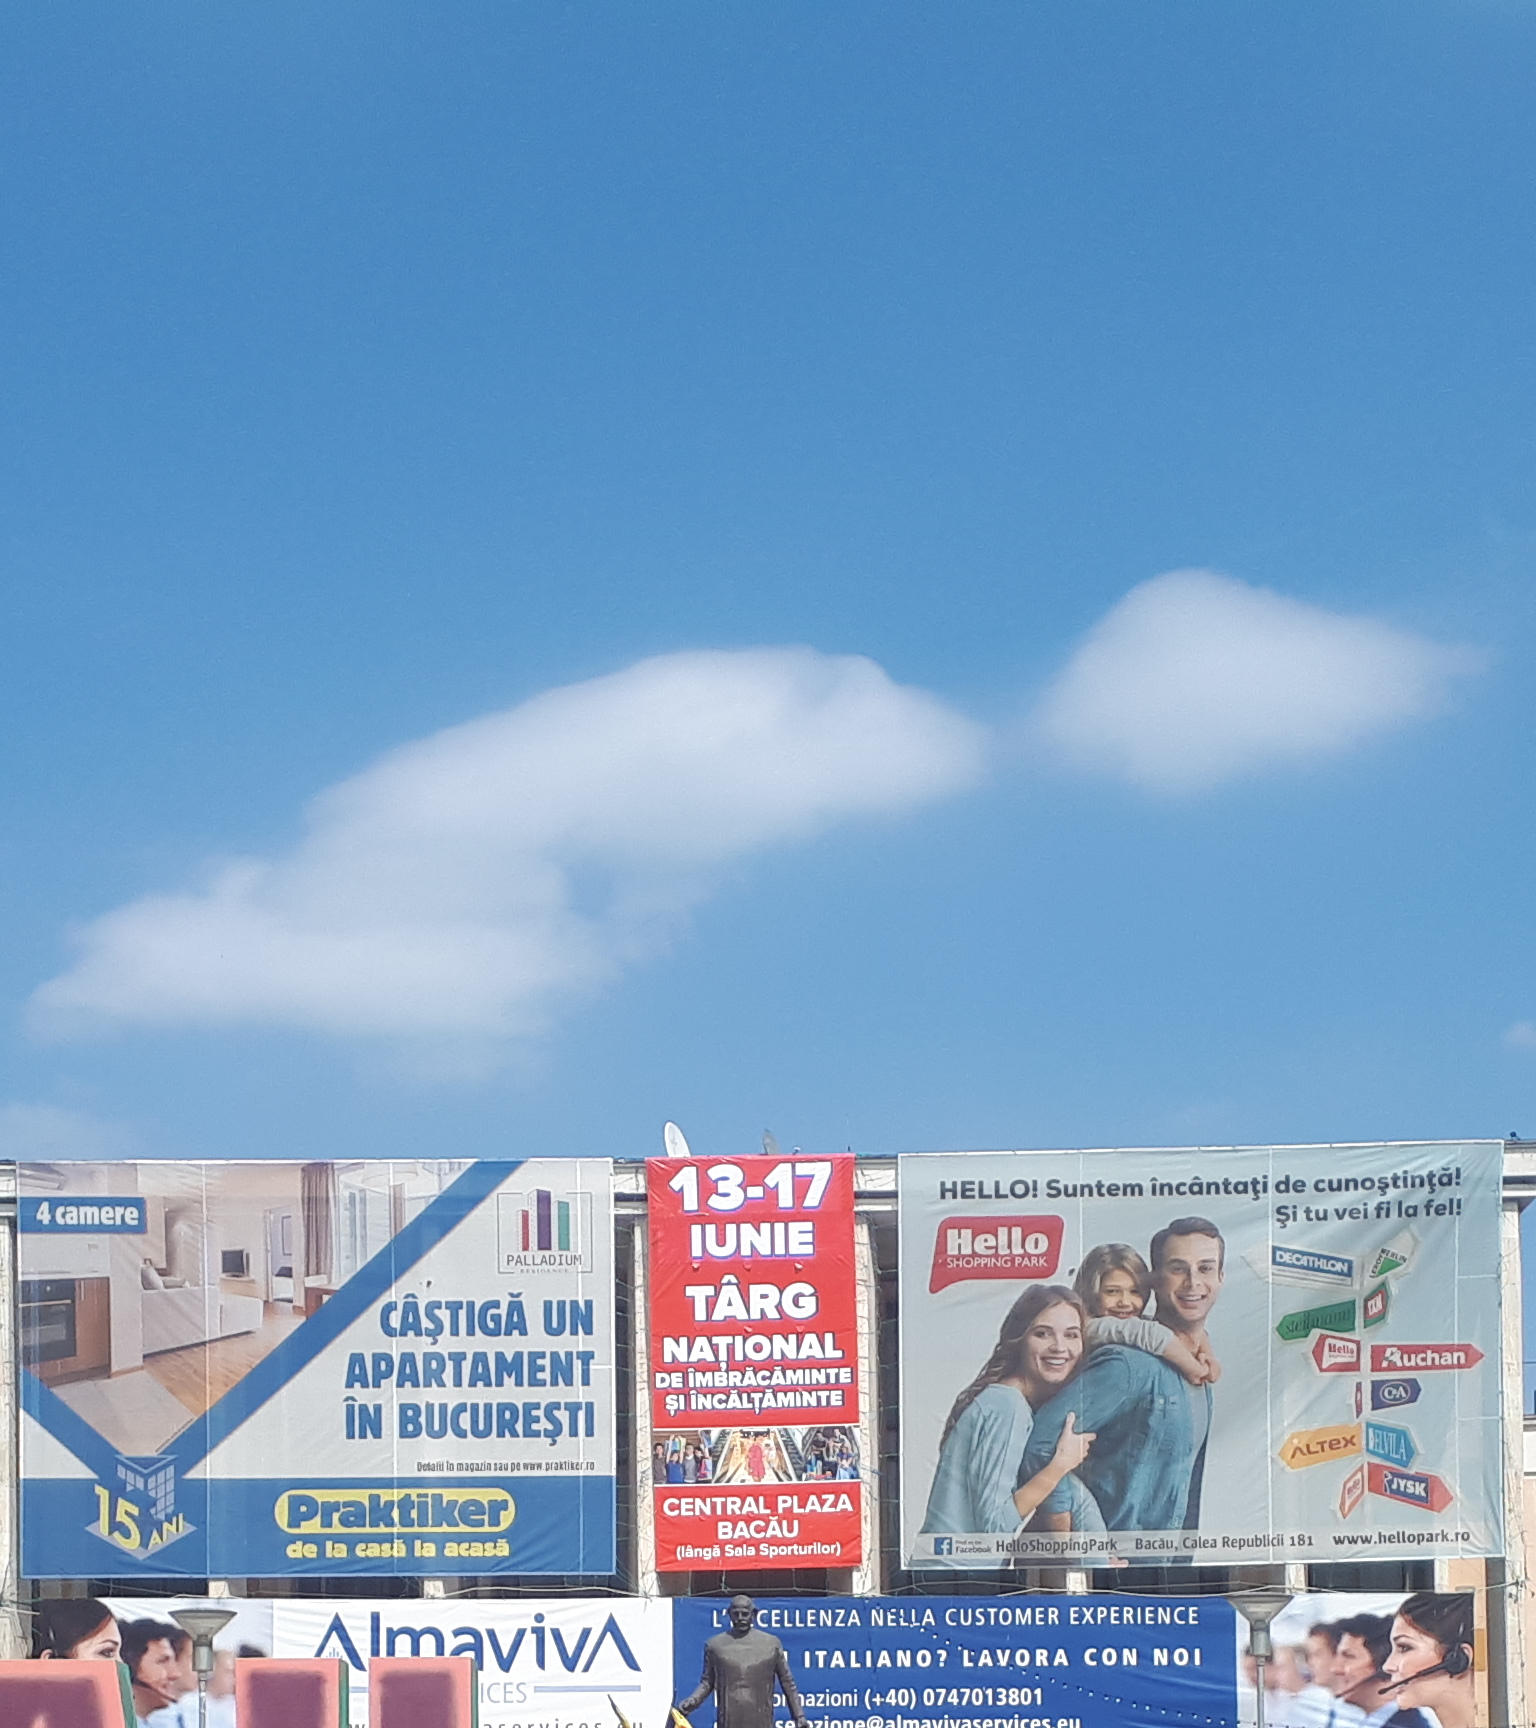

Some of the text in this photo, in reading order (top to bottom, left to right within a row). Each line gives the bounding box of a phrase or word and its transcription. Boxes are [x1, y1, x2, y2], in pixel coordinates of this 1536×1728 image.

[668, 1160, 833, 1213] 13-17
[939, 1178, 1038, 1200] HELLO!
[1046, 1178, 1144, 1198] Suntem
[1275, 1174, 1307, 1194] de
[36, 1201, 139, 1226] 4 camere
[1304, 1207, 1328, 1222] tu
[1333, 1203, 1368, 1221] vei
[1374, 1201, 1391, 1218] fi
[1398, 1200, 1418, 1217] la
[1424, 1198, 1462, 1216] fel!
[690, 1221, 815, 1259] IUNIE
[946, 1226, 1050, 1256] Hello
[506, 1254, 582, 1266] PALLADIUM
[947, 1256, 1047, 1269] SHOPPING PARK
[1275, 1250, 1349, 1274] DECATHLON
[685, 1274, 818, 1322] TÂRG
[543, 1300, 594, 1336] UN
[345, 1351, 595, 1388] APARTAMENT
[1381, 1347, 1465, 1368] Auchan
[655, 1366, 852, 1388] DE ÎMBRĂCĂMINTE
[343, 1396, 382, 1439] ÎN
[456, 1461, 491, 1473] magazin
[494, 1461, 509, 1471] sau
[510, 1461, 521, 1473] pe
[523, 1460, 595, 1472] www.praktiker.ro
[1390, 1478, 1427, 1497] JYSK
[94, 1483, 141, 1550] 15
[286, 1493, 509, 1529] Praktiker
[663, 1493, 853, 1517] CENTRAL PLAZA
[147, 1512, 185, 1551] ANI
[717, 1516, 799, 1540] BACĂU
[1333, 1529, 1470, 1545] www.hellopark.ro
[286, 1538, 510, 1558] de la casă la acasă
[676, 1542, 841, 1560] (lângă Sala Sporturilor)
[996, 1537, 1118, 1554] HelloShoppingPark
[1135, 1534, 1314, 1552] Bacău, Calea Republicii 181
[871, 1608, 935, 1626] NELLA
[945, 1607, 1059, 1626] CUSTOMER
[1070, 1606, 1200, 1625] EXPERIENCE
[804, 1649, 948, 1668] ITALIANO?
[963, 1648, 1069, 1667] LAVORA
[1084, 1648, 1138, 1667] CON
[1153, 1648, 1202, 1666] NOI
[864, 1688, 916, 1710] (+40)
[923, 1688, 1043, 1706] 0747013801
